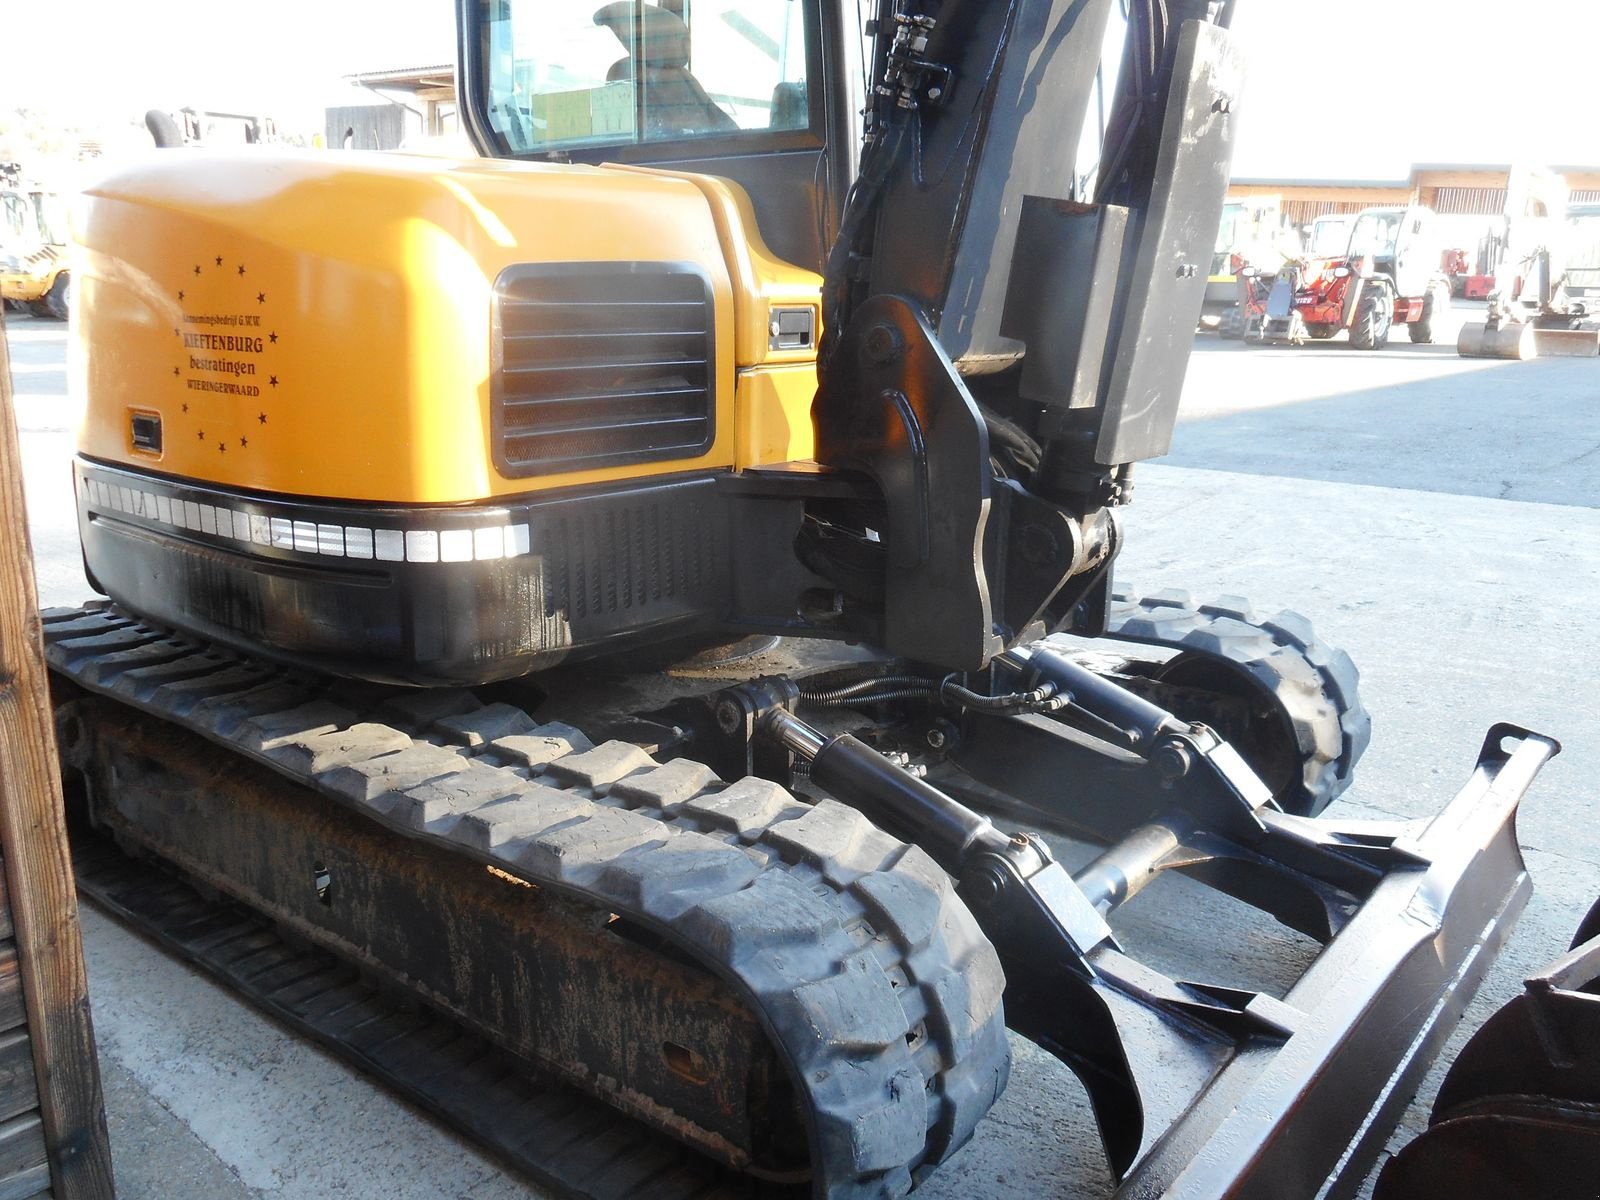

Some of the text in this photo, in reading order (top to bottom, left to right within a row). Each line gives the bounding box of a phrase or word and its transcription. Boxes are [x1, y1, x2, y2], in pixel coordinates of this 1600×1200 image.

[184, 333, 263, 353] KIEFTENBURG
[190, 355, 256, 377] bestratingen
[187, 379, 260, 397] WIERINGERWAARD
